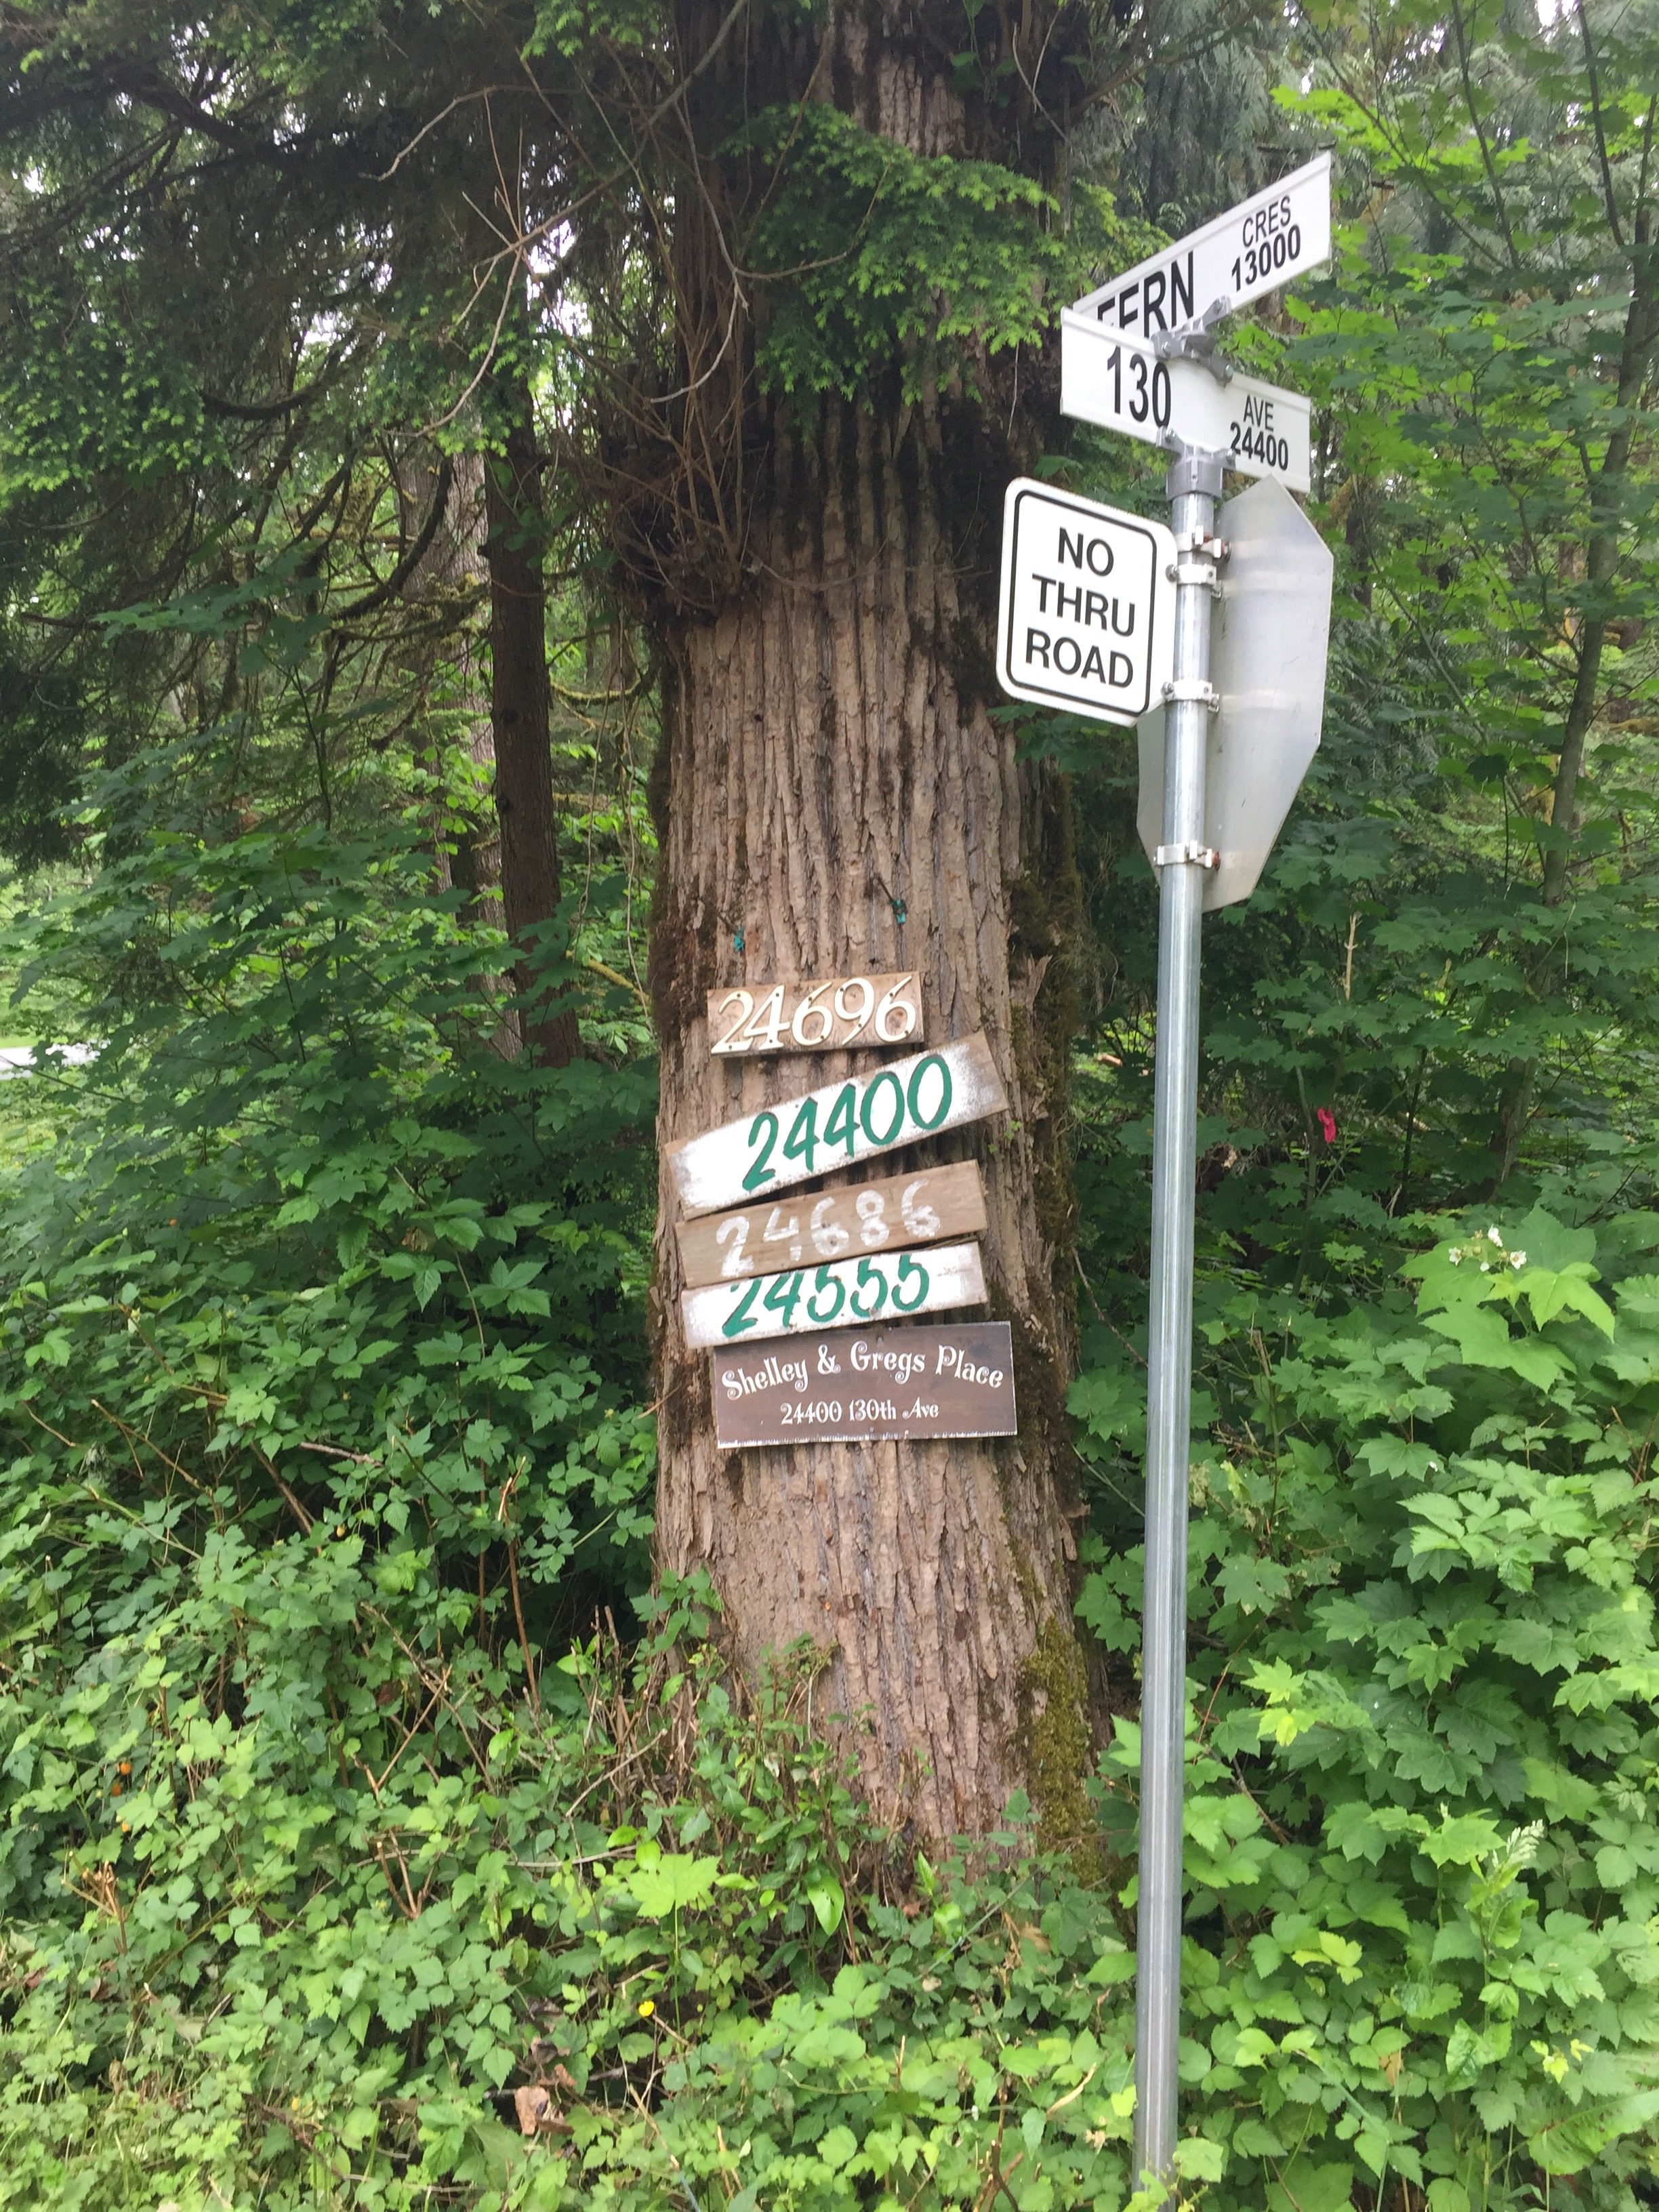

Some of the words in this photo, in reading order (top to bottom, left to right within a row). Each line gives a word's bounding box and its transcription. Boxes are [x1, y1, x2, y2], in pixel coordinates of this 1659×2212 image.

[1242, 196, 1291, 247] CRES
[1231, 224, 1301, 292] 13000
[1107, 344, 1172, 427] 130
[1243, 394, 1274, 432] AVE
[1230, 421, 1288, 470] 24400
[1057, 527, 1114, 576] NO
[1031, 573, 1135, 636] THRU
[1025, 628, 1133, 688] ROAD
[711, 975, 916, 1054] 24696
[742, 1054, 952, 1191] 24400
[716, 1179, 941, 1277] 24686
[722, 1254, 930, 1338] 24555
[722, 1356, 808, 1401] Shelley
[817, 1344, 841, 1375] &
[850, 1340, 926, 1385] Gregs
[935, 1344, 1004, 1389] Place
[780, 1399, 842, 1425] 24400
[848, 1398, 897, 1422] 130th
[902, 1397, 939, 1420] Ave
